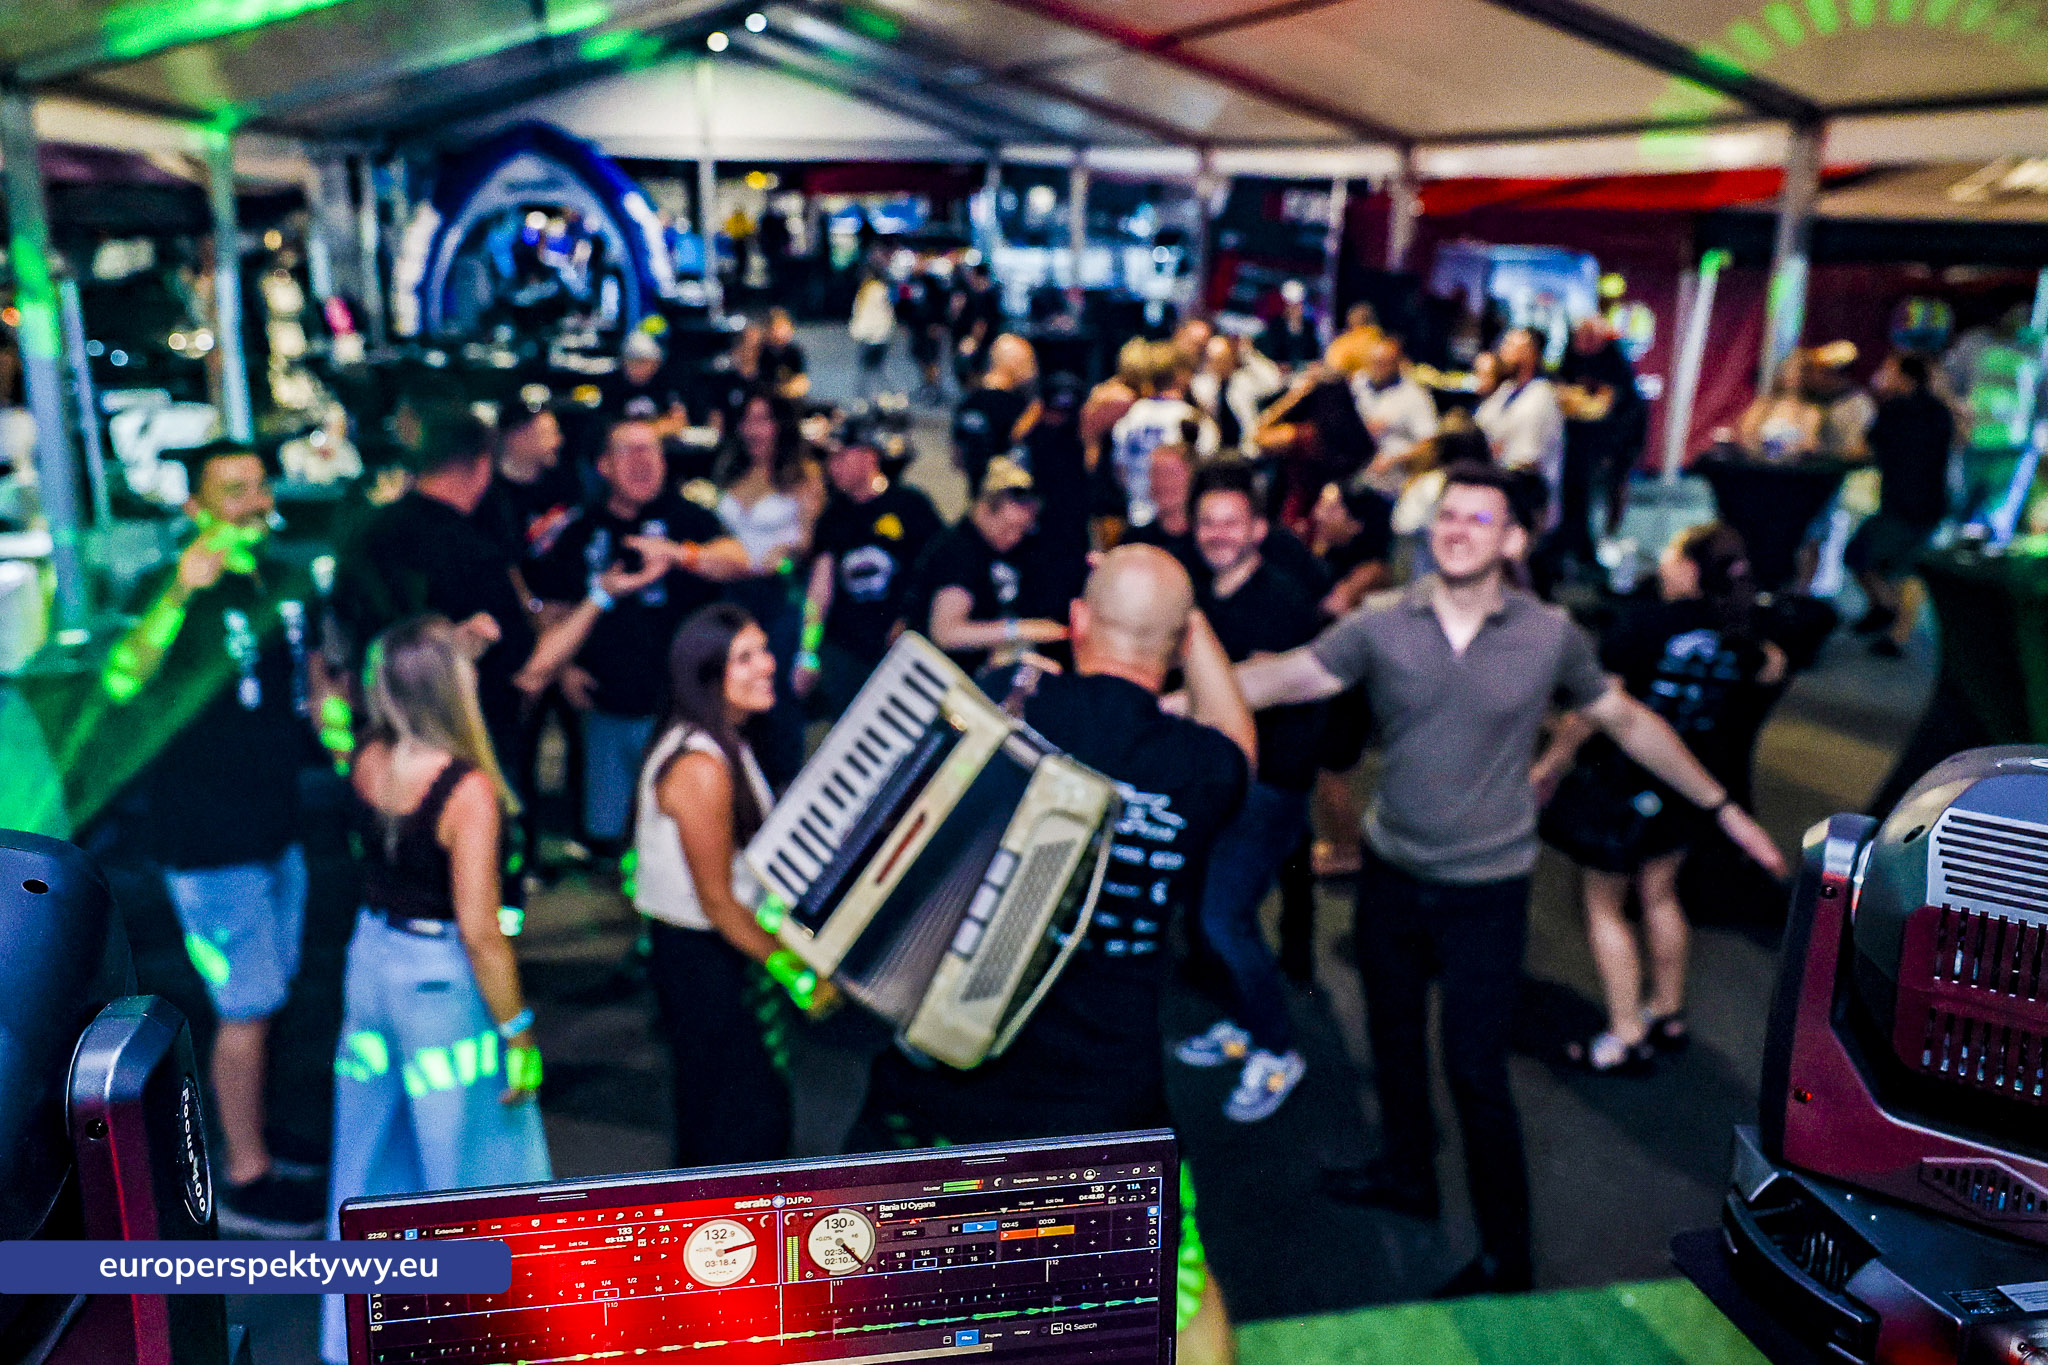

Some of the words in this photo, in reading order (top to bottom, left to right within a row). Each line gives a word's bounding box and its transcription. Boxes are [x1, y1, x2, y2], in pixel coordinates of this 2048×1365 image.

[1090, 1185, 1104, 1193] 130
[734, 1198, 771, 1209] serato
[786, 1196, 796, 1204] DJ
[797, 1195, 812, 1204] Pro
[879, 1204, 899, 1212] Bania
[908, 1201, 936, 1211] Cygana
[659, 1224, 670, 1232] 2A
[824, 1217, 855, 1230] 130.0
[617, 1227, 633, 1235] 133
[704, 1228, 735, 1240] 132.9
[1073, 1322, 1098, 1330] Search
